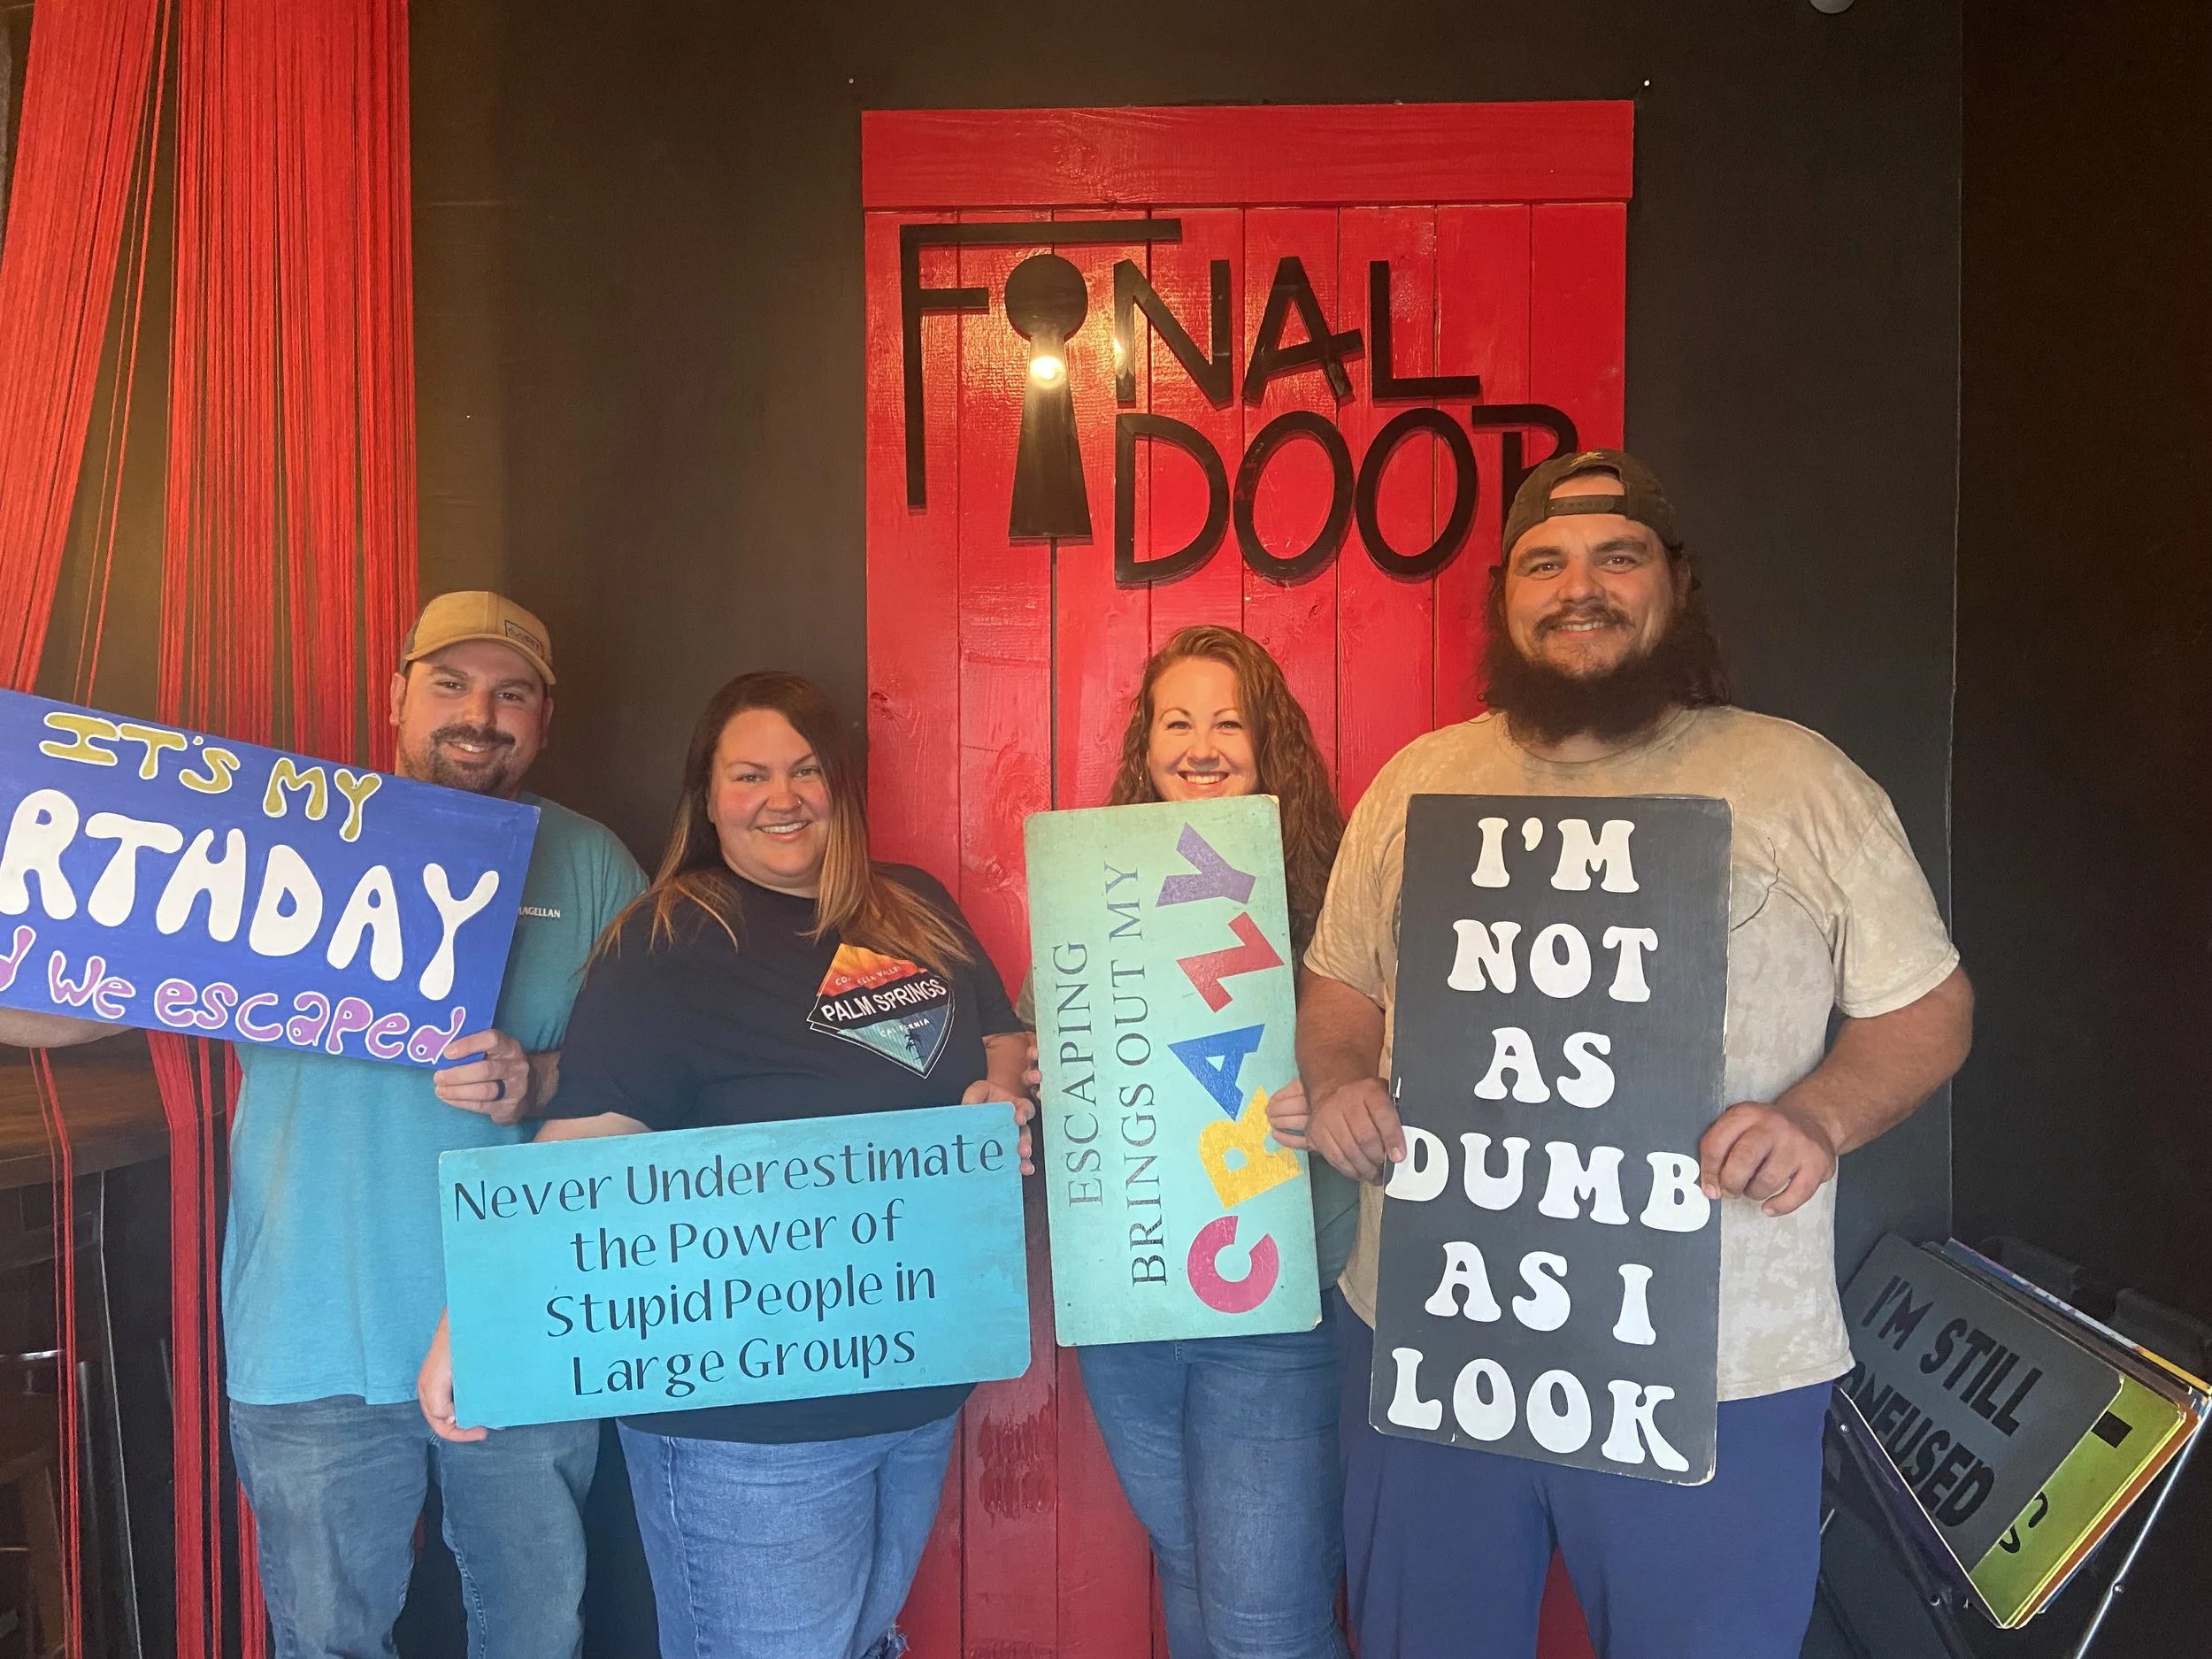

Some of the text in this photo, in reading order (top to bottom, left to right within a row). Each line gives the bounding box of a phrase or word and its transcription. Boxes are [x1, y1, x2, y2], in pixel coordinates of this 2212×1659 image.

[40, 711, 382, 842] IT'S MY
[1471, 817, 1640, 894] I'M
[820, 979, 947, 1022] PALM SPRINGS
[1447, 918, 1659, 1003] NOT
[154, 978, 465, 1064] escaped
[1052, 941, 1104, 1209] ESCAPING
[1103, 860, 1169, 1286] BRINGS OUT MY
[1154, 821, 1304, 1315] CRAZY
[1473, 1026, 1617, 1109] AS
[454, 1133, 1004, 1223] Never Underestimate
[1385, 1124, 1712, 1233] DUMB
[570, 1198, 905, 1273] the Power of
[545, 1262, 936, 1340] Stupid People in
[1425, 1240, 1657, 1345] AS I
[572, 1328, 917, 1398] Large Groups
[1861, 1275, 2043, 1437] I'M STILL
[1387, 1347, 1690, 1473] LOOK
